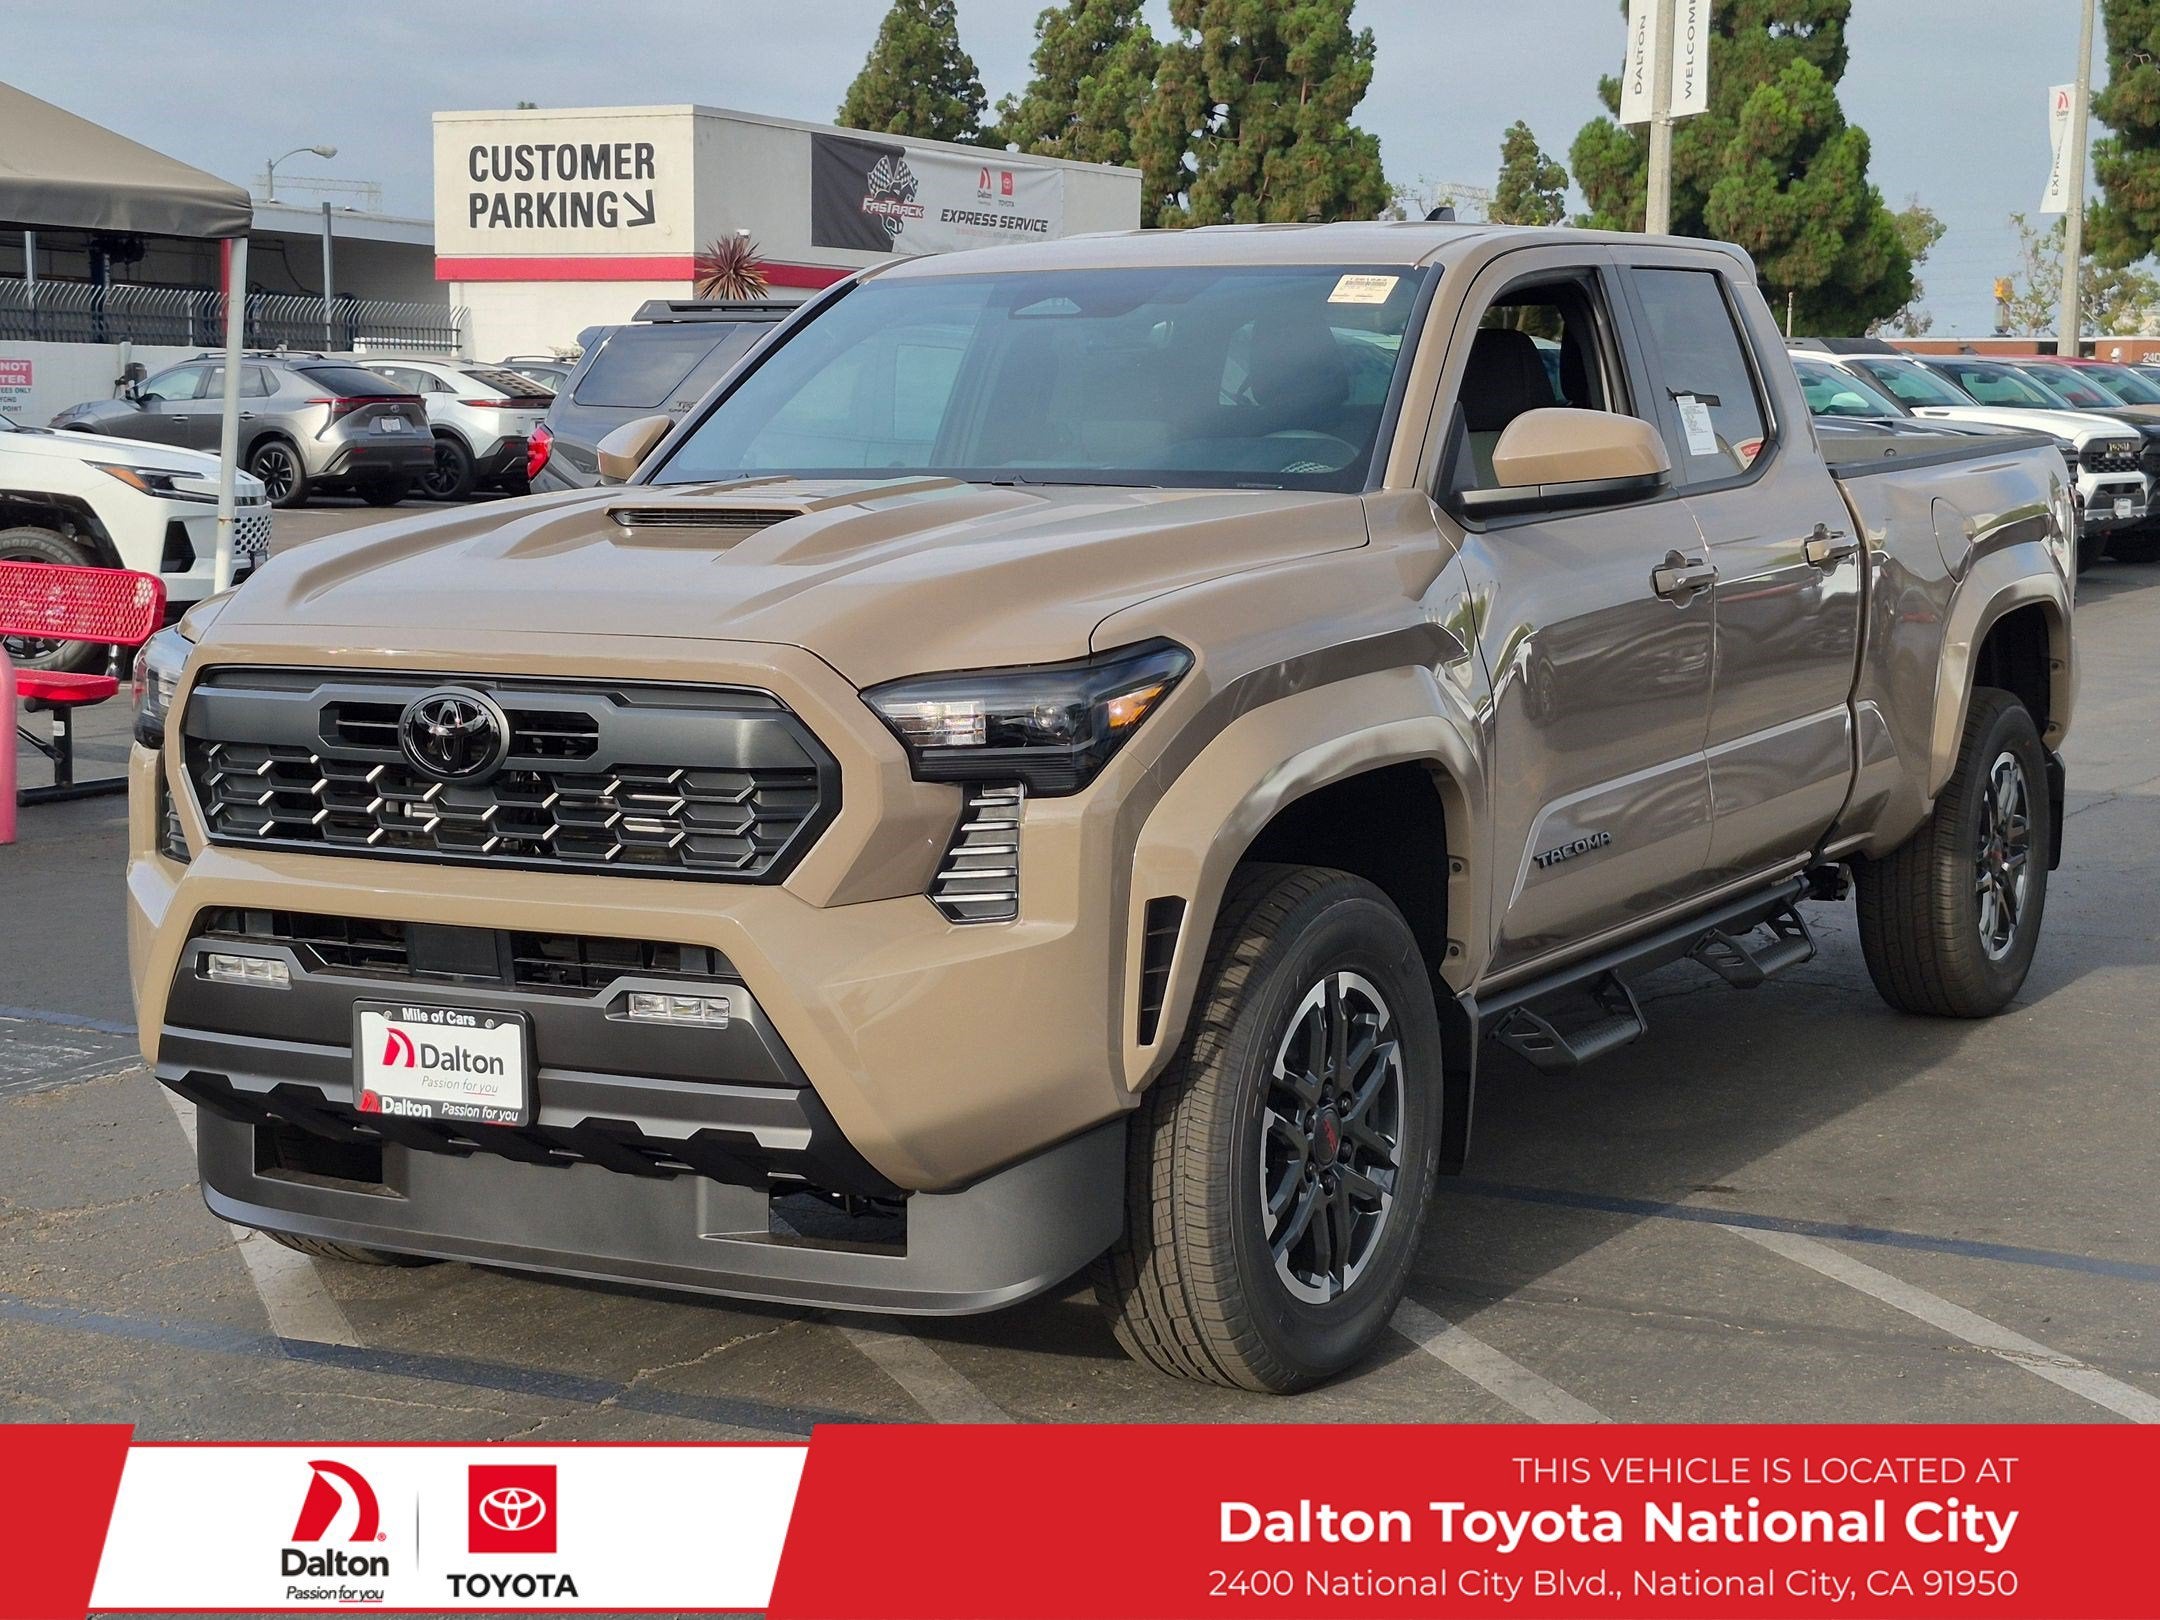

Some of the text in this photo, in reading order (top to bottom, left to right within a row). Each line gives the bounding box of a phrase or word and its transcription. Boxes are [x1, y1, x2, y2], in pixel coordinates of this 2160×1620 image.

[1635, 15, 1647, 95] DALTON
[469, 143, 655, 182] CUSTOMER
[469, 191, 618, 228] PARKING
[940, 209, 1049, 233] EXPRESS SERVICE
[0, 362, 29, 371] NOT
[1534, 831, 1611, 868] TACOMA
[402, 1007, 476, 1026] Mile of Cars
[420, 1043, 504, 1075] Dalton
[421, 1075, 498, 1095] Passion for you
[382, 1097, 519, 1122] Dalton Passion for you
